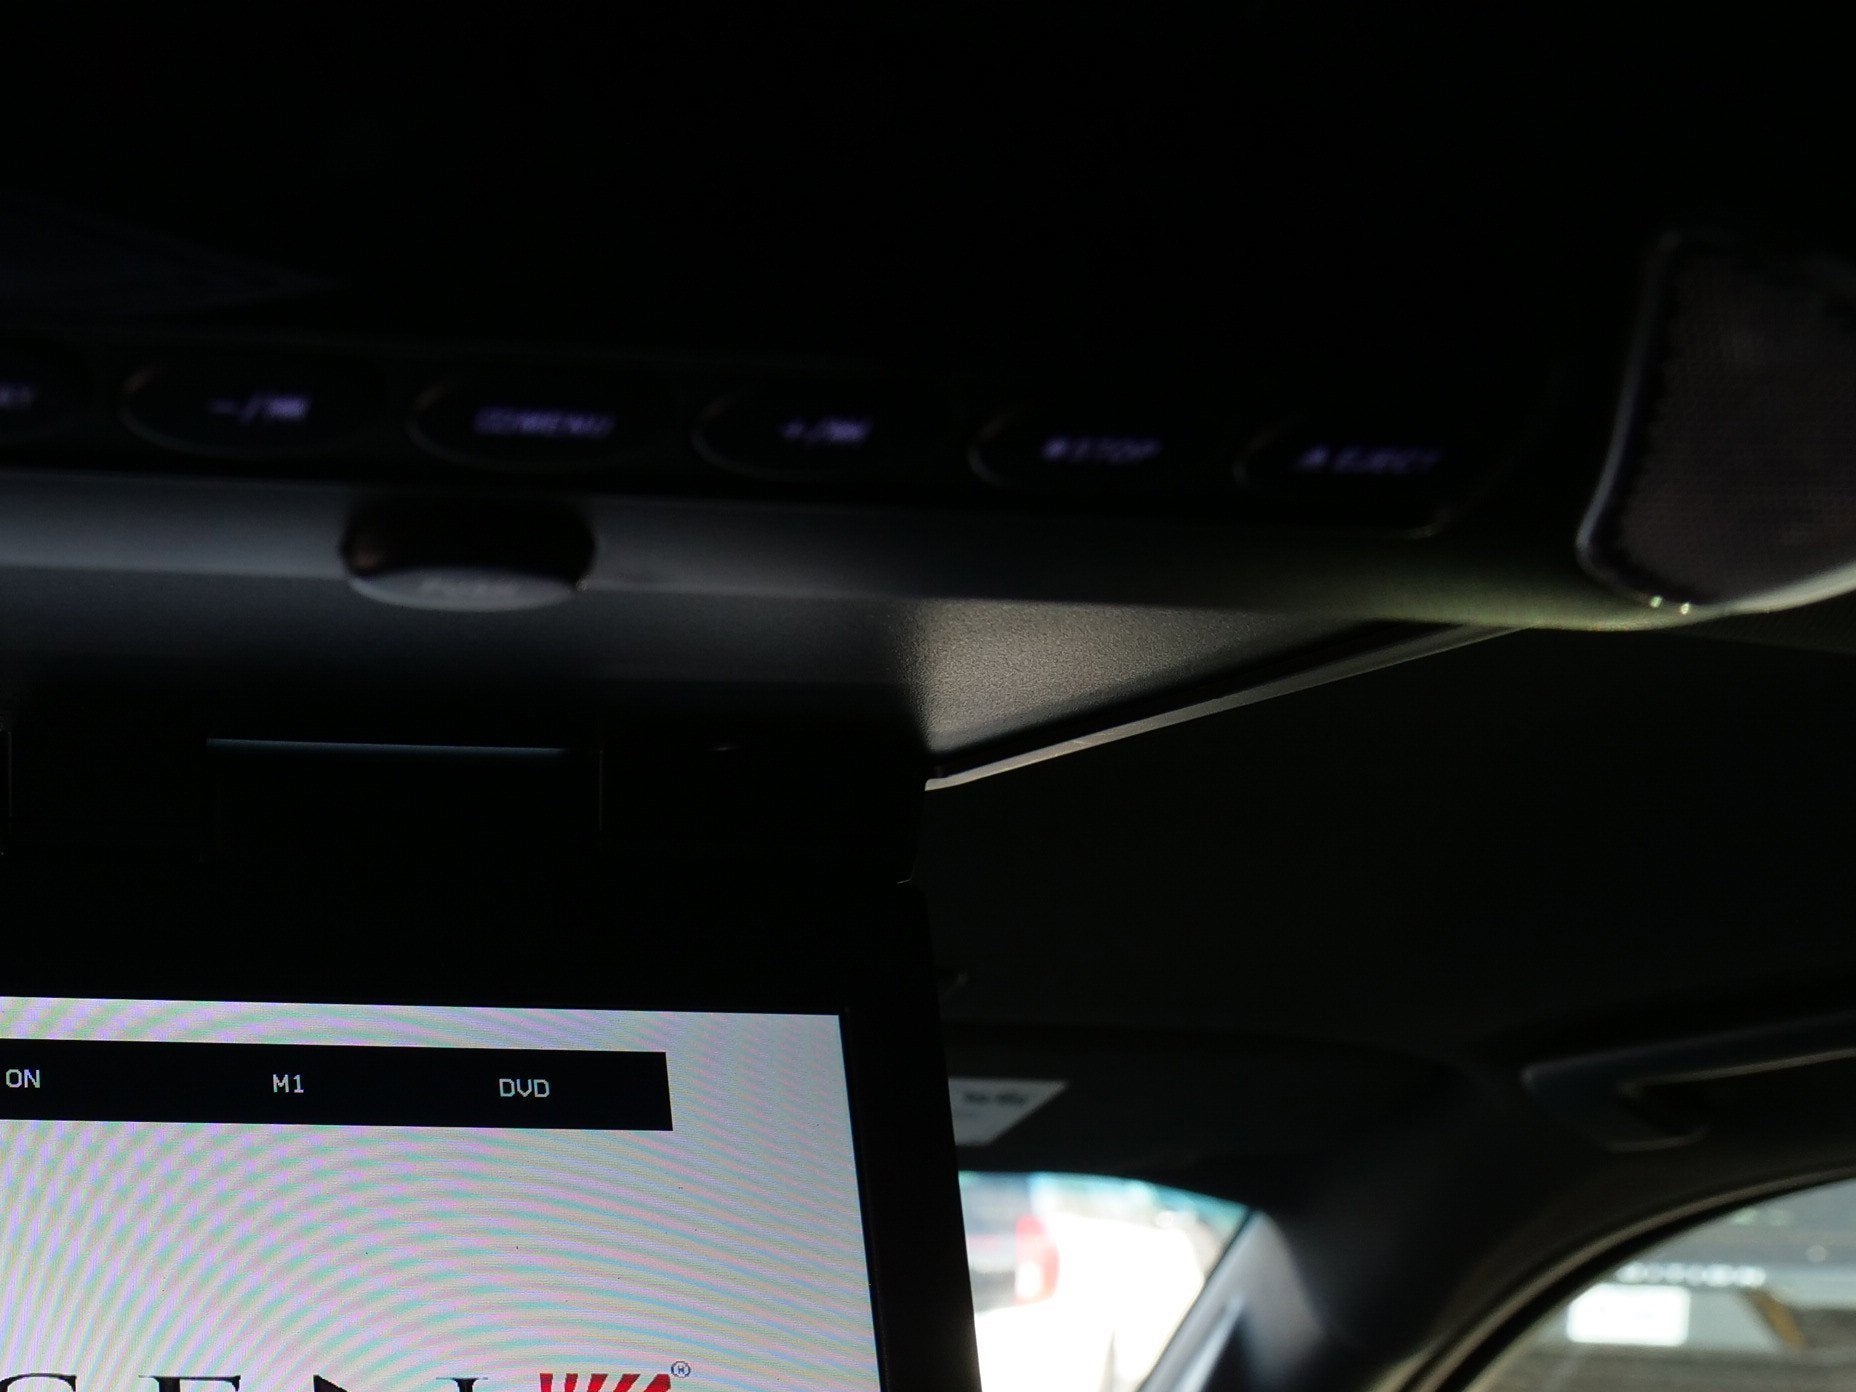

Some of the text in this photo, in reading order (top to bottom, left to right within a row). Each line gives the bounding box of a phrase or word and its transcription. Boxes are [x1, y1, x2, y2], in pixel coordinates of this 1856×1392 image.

[4, 1068, 42, 1089] ON
[271, 1073, 305, 1094] M1
[498, 1078, 551, 1098] DVD
